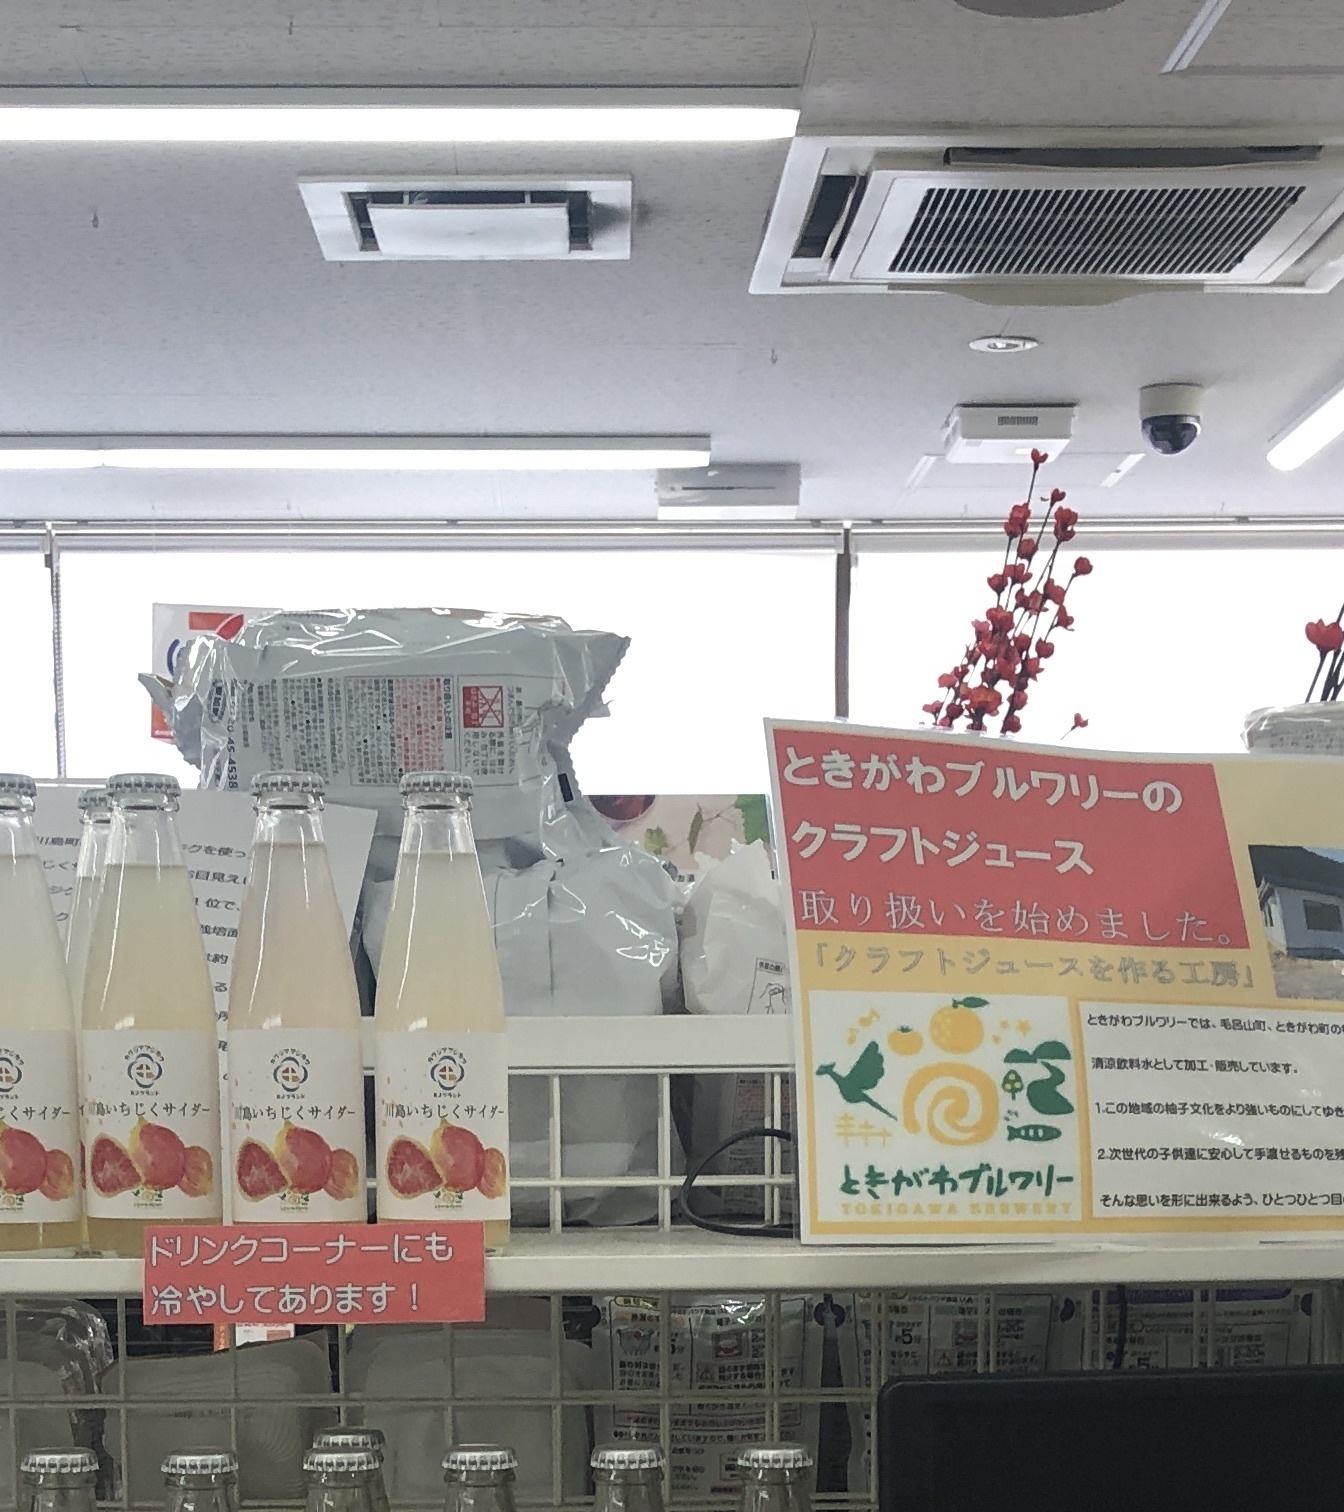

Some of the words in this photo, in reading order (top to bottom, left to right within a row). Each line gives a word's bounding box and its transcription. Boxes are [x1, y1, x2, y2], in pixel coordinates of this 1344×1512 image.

[783, 746, 1182, 816] ときがわブルワリーの
[791, 821, 1094, 875] クラフトジュース
[799, 889, 1233, 948] 取り扱いを始めました。
[813, 940, 1254, 989] 「クラフトジュースを作る工房」
[1091, 1056, 1299, 1075] 清涼飲料水として加工・販売しています。
[89, 1102, 211, 1120] 川島いちじくサイダー
[233, 1104, 356, 1121] 川島いちじくサイダー
[384, 1104, 506, 1121] 川島いちじくサイダー
[840, 1161, 1074, 1198] ときがわブルワリー
[151, 1231, 454, 1267] ドリンクコーナーにも
[151, 1281, 420, 1316] 冷やしてあります！
